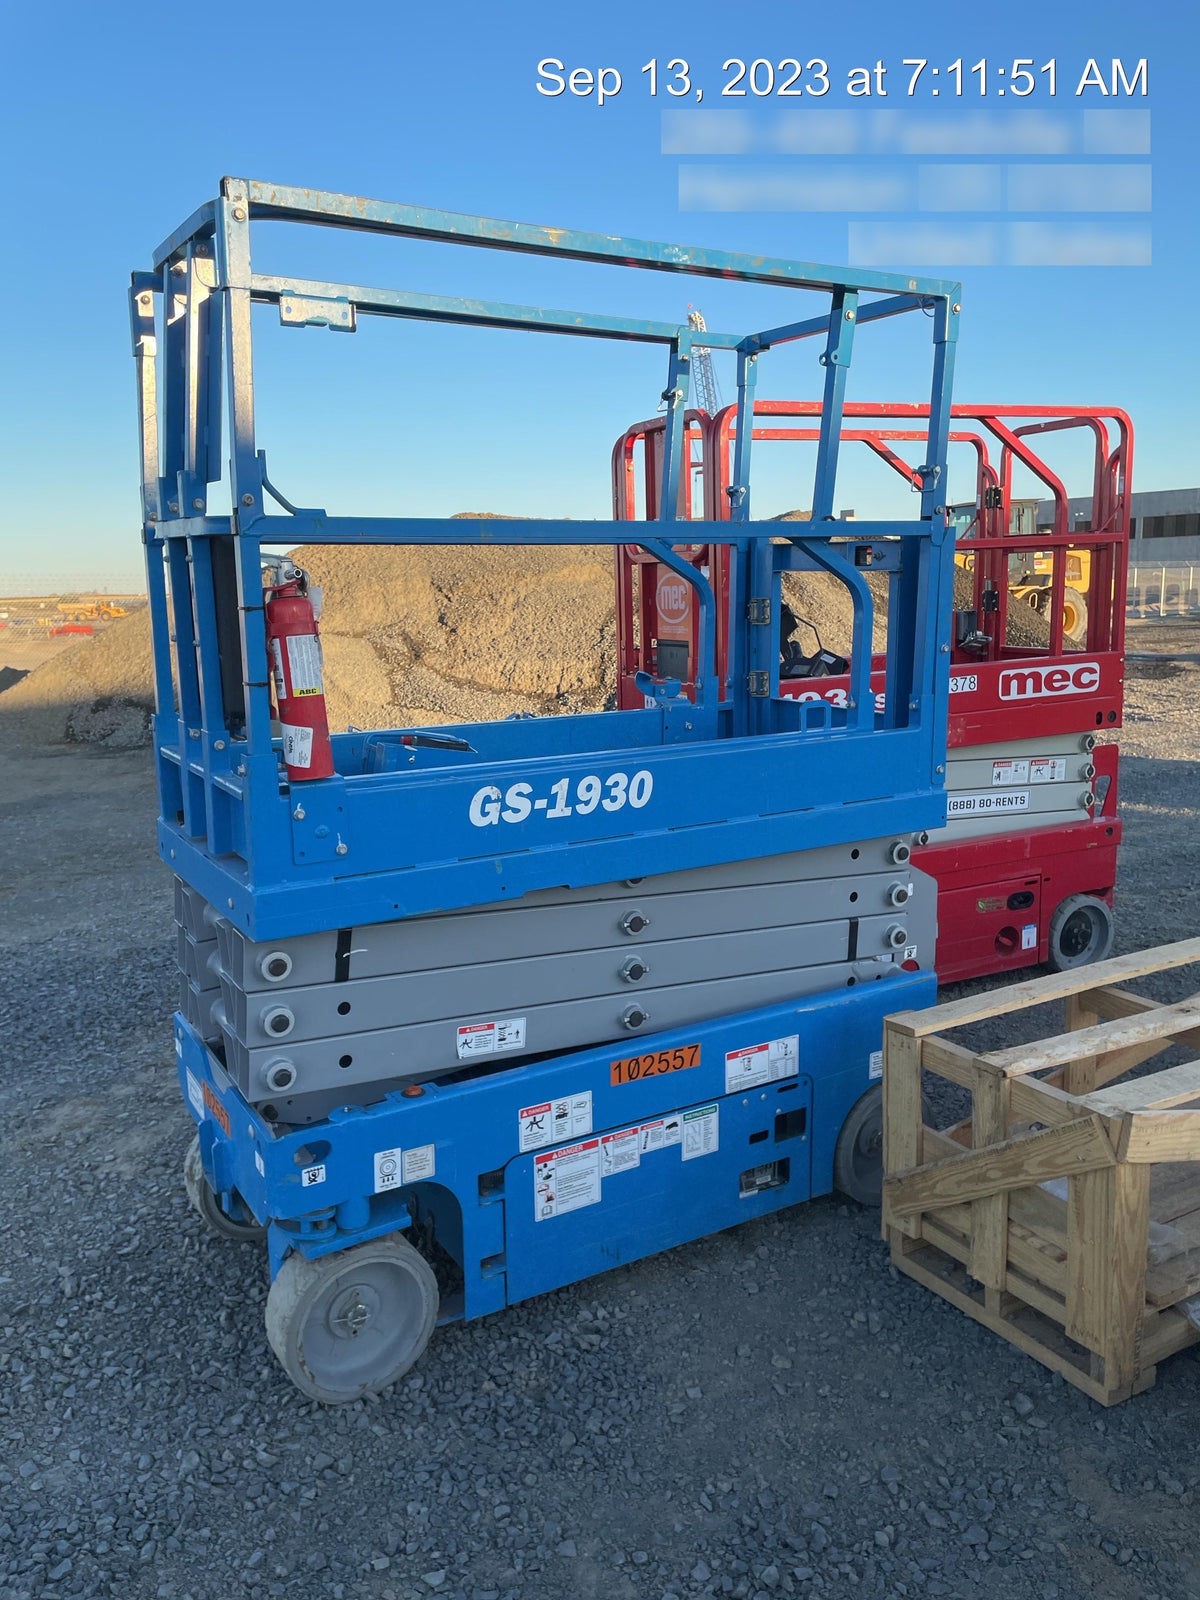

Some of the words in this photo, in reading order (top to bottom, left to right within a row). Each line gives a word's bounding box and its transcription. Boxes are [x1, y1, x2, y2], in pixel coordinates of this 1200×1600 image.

[661, 585, 687, 610] mec
[950, 675, 977, 692] 378
[1001, 666, 1098, 697] mec
[468, 770, 654, 828] GS-1930
[948, 798, 976, 811] (888)
[978, 795, 1026, 808] 80-RENTS
[613, 1044, 700, 1084] 102557
[528, 1105, 550, 1116] DANGER
[557, 1144, 584, 1158] DANGER
